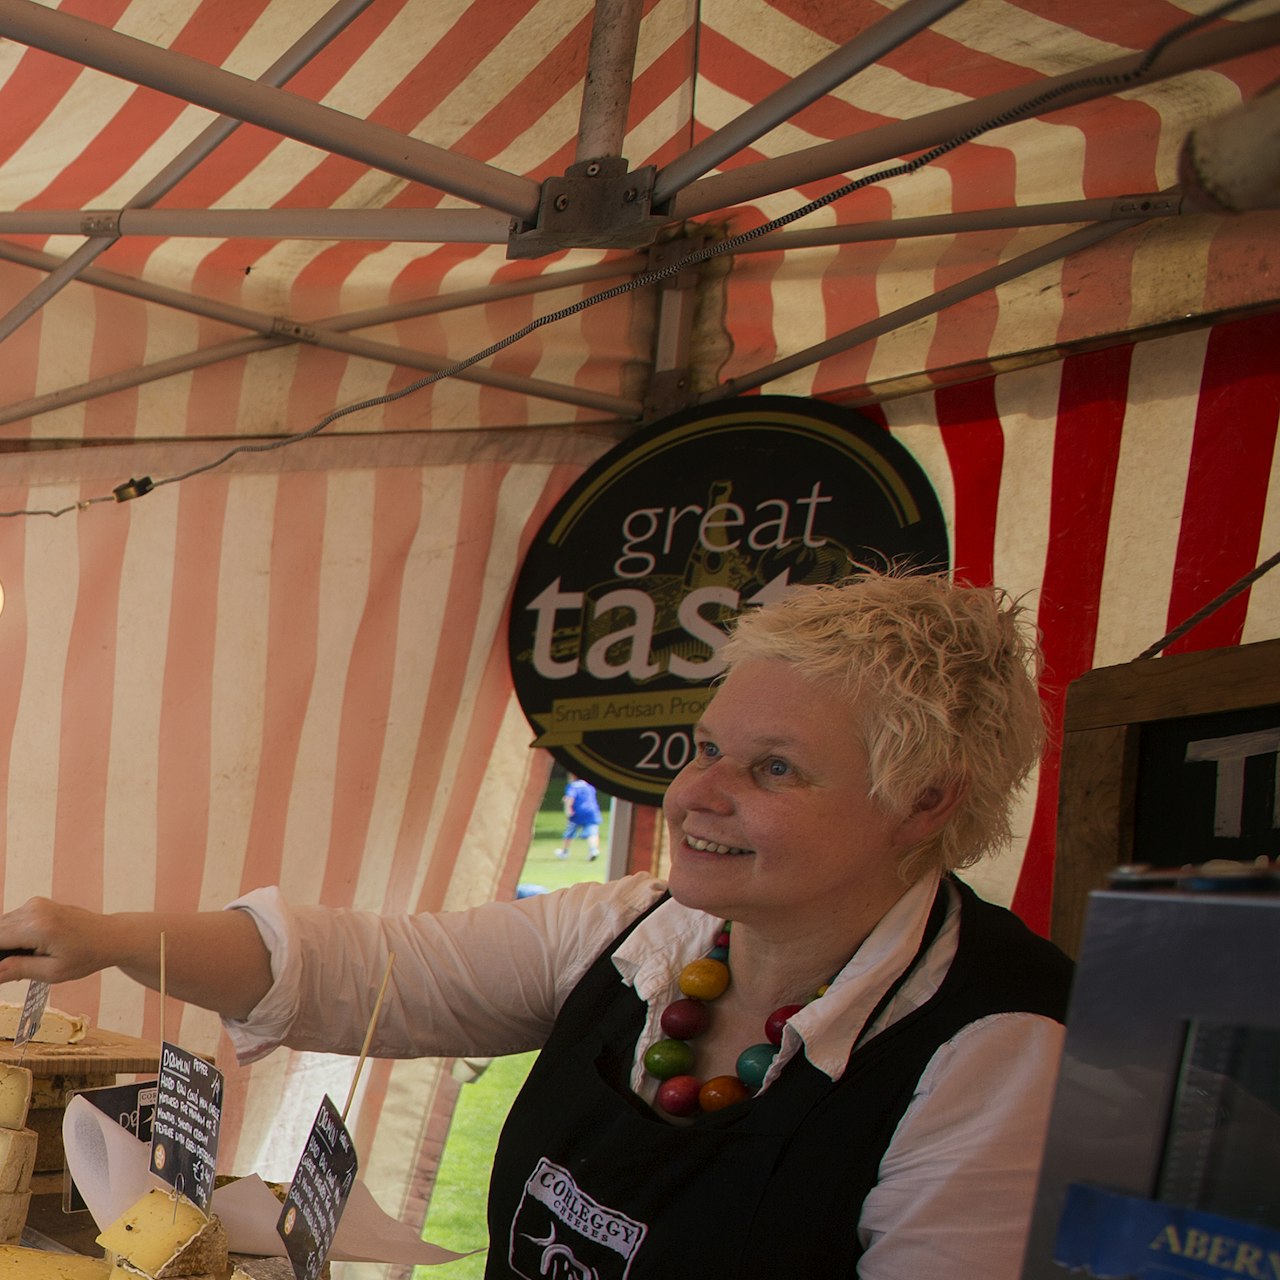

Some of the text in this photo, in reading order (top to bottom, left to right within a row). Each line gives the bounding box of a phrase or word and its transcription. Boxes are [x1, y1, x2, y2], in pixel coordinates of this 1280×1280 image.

[614, 481, 833, 579] great
[603, 700, 664, 719] Artisan
[635, 730, 691, 770] 20
[1184, 727, 1280, 838] T
[540, 1171, 634, 1245] CORLEGGY
[553, 1200, 608, 1243] CHEESES
